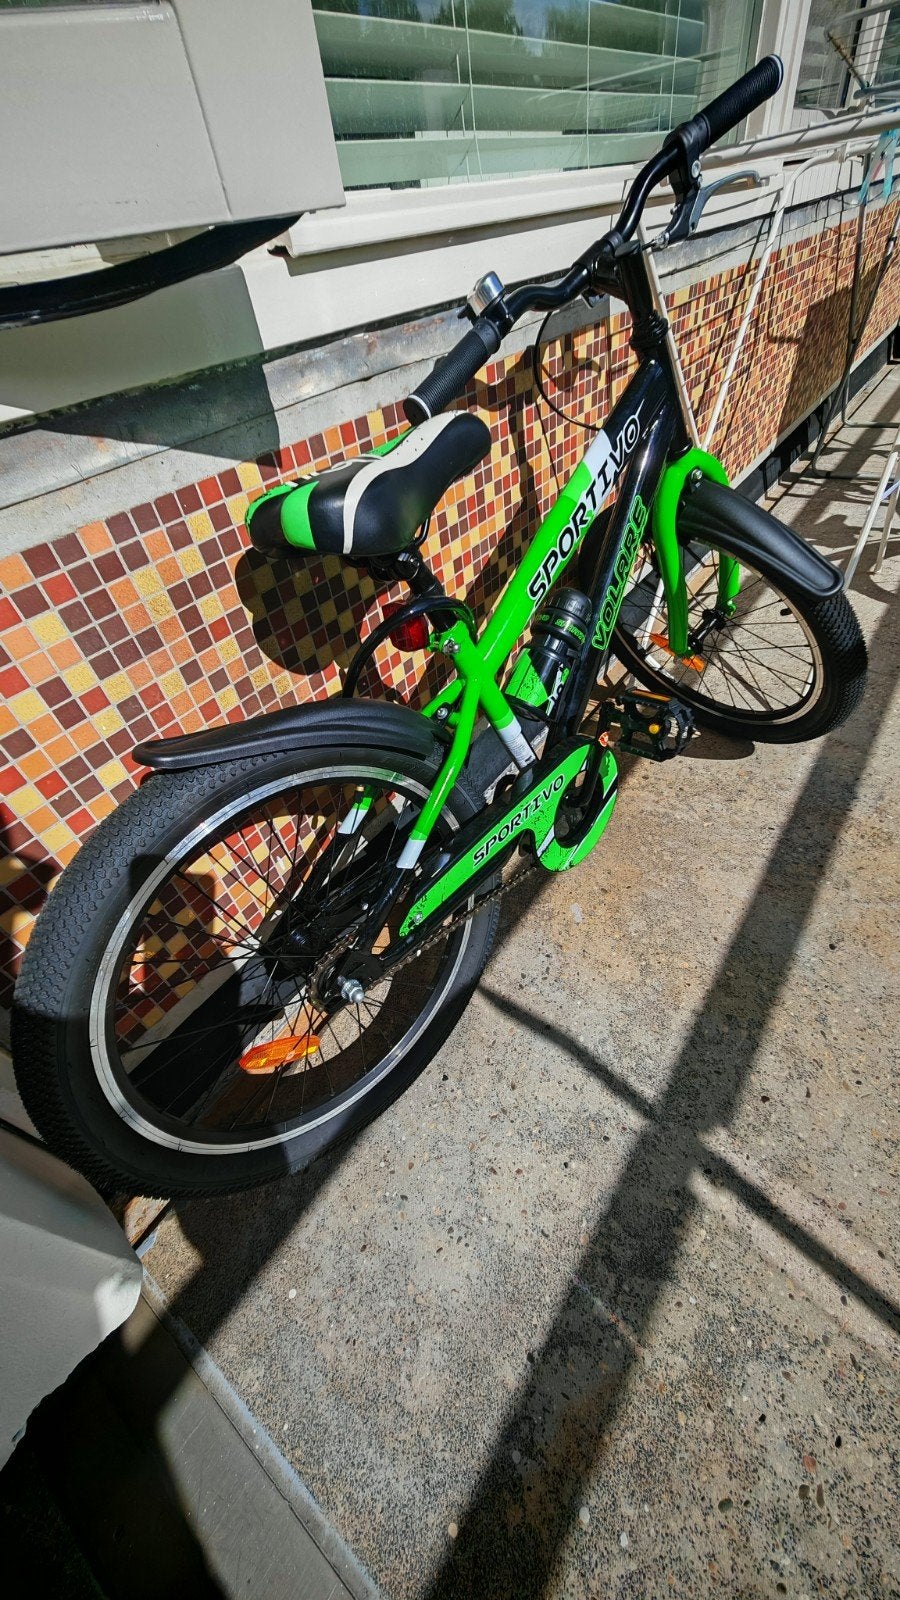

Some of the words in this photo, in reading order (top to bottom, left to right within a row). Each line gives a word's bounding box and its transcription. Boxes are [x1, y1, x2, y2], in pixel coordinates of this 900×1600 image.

[527, 413, 641, 607] SPORTIVO
[592, 494, 649, 650] VOLARE
[472, 774, 566, 869] SPORTIVO
